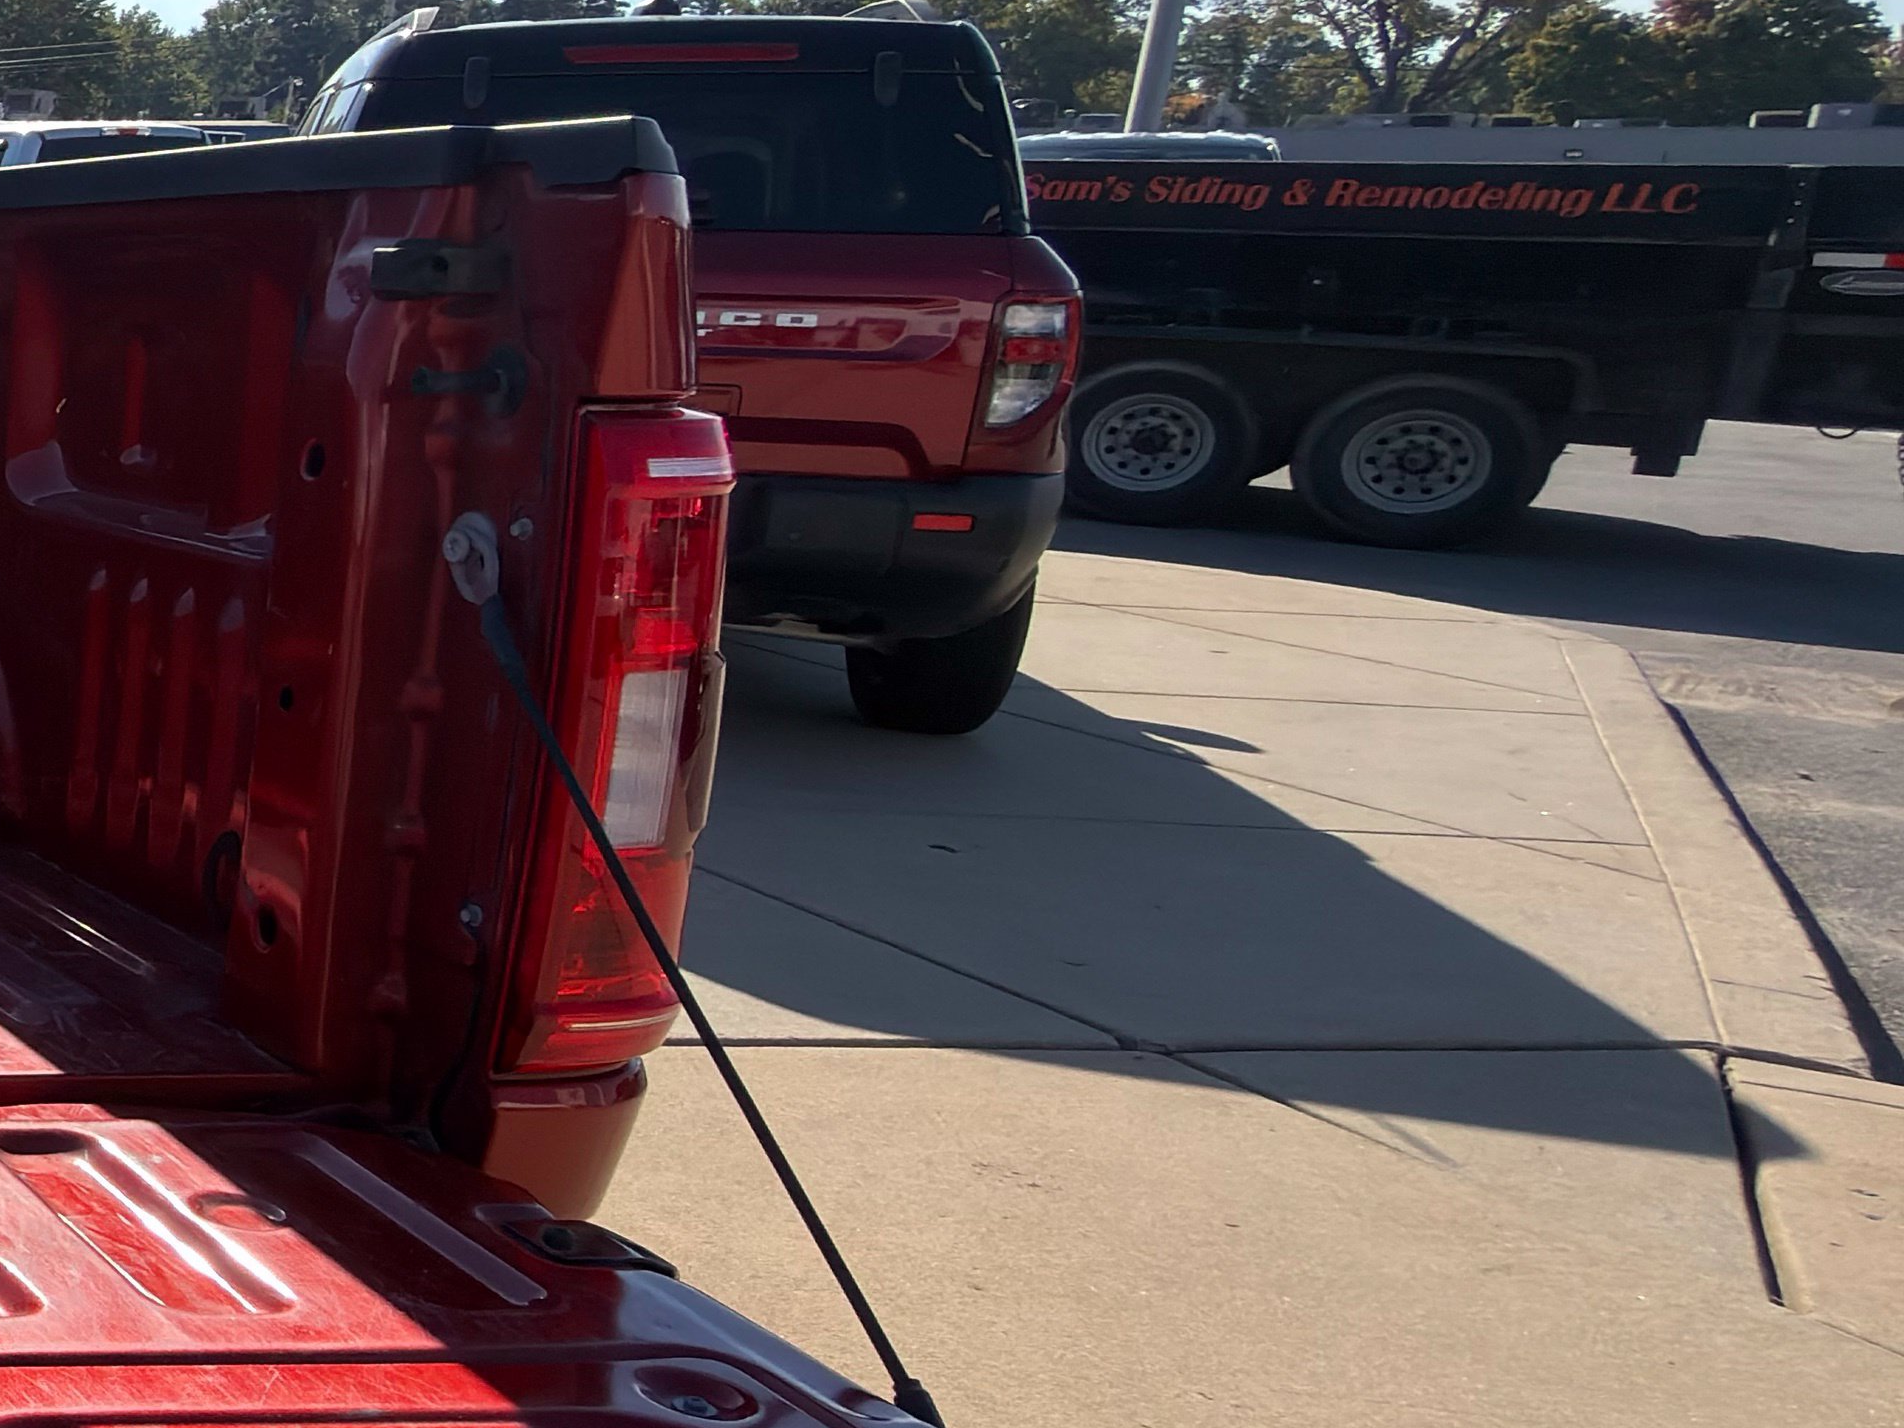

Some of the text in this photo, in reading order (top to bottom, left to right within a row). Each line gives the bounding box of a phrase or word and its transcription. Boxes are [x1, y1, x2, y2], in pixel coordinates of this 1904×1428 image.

[1026, 175, 1701, 218] Sam's Siding & Remodeling LLC
